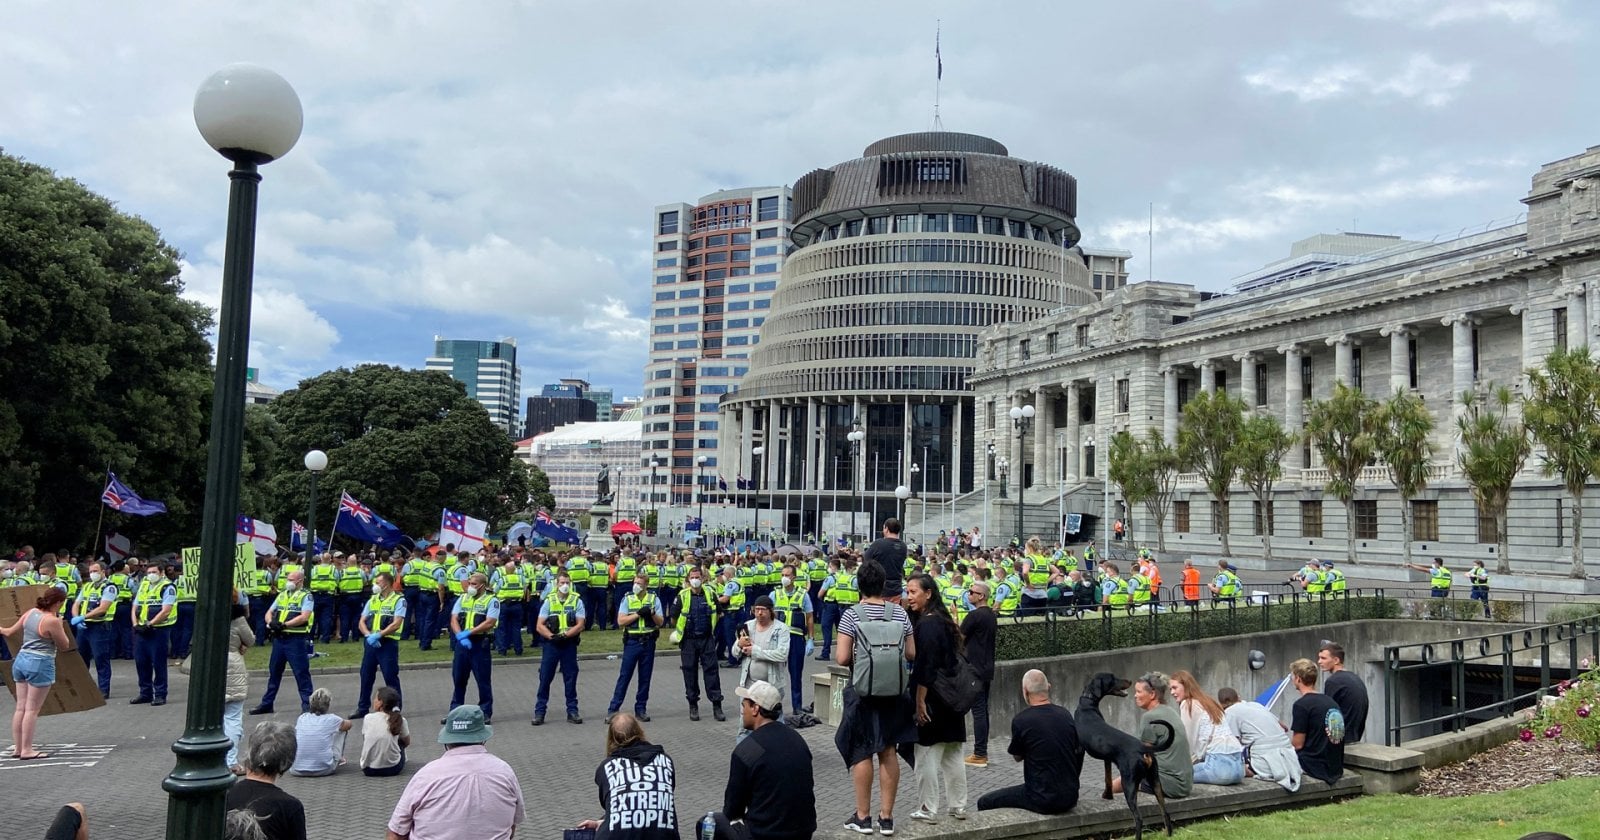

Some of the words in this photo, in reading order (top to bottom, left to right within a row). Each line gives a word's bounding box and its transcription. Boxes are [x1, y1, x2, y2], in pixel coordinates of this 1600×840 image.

[604, 753, 673, 778] EXTME
[608, 766, 673, 790] MUSIC
[610, 782, 673, 796] FOR
[610, 791, 674, 813] EXTREME
[609, 809, 674, 832] PEOPLE
